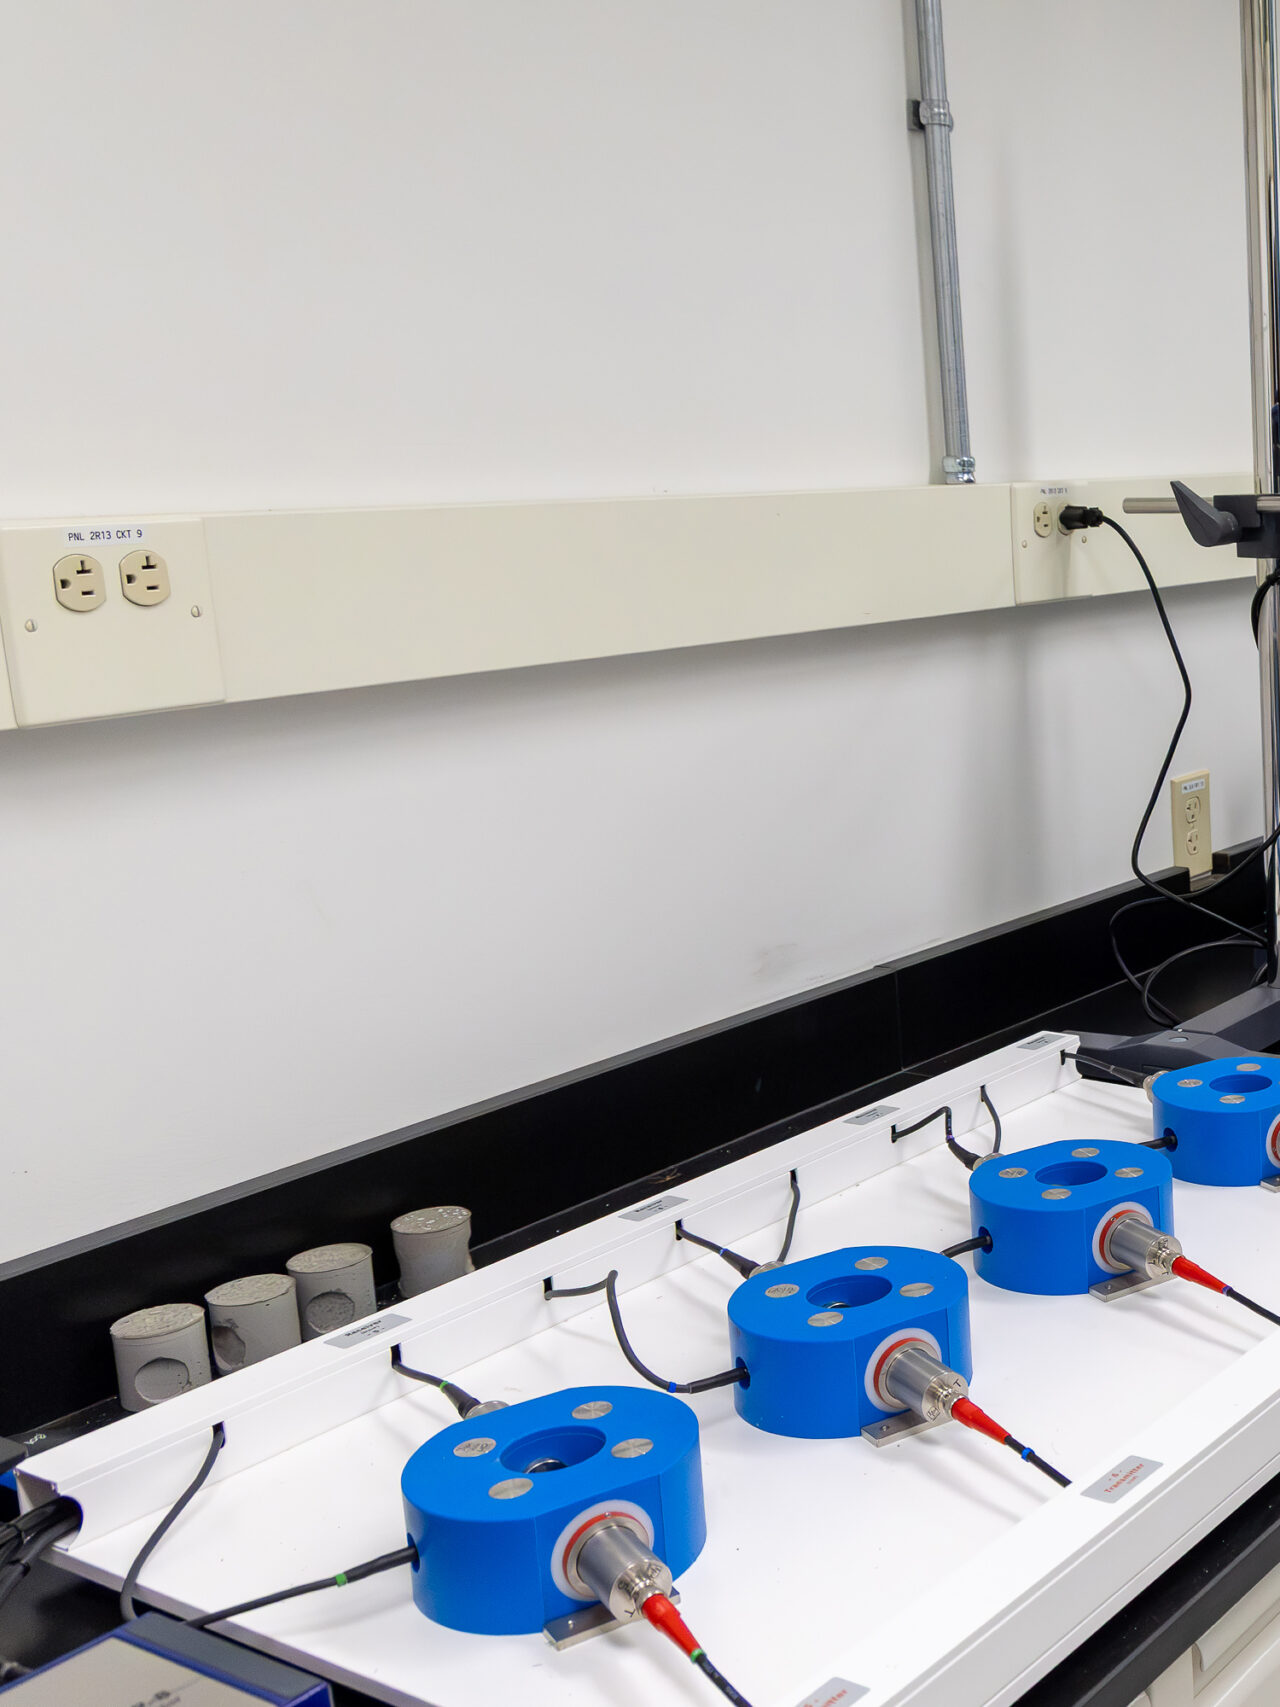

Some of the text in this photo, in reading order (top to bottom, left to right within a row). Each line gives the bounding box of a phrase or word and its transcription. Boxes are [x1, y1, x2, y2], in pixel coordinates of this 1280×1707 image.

[68, 528, 143, 541] PNL 2R13 CKT 9
[1103, 1463, 1145, 1493] Transmitter
